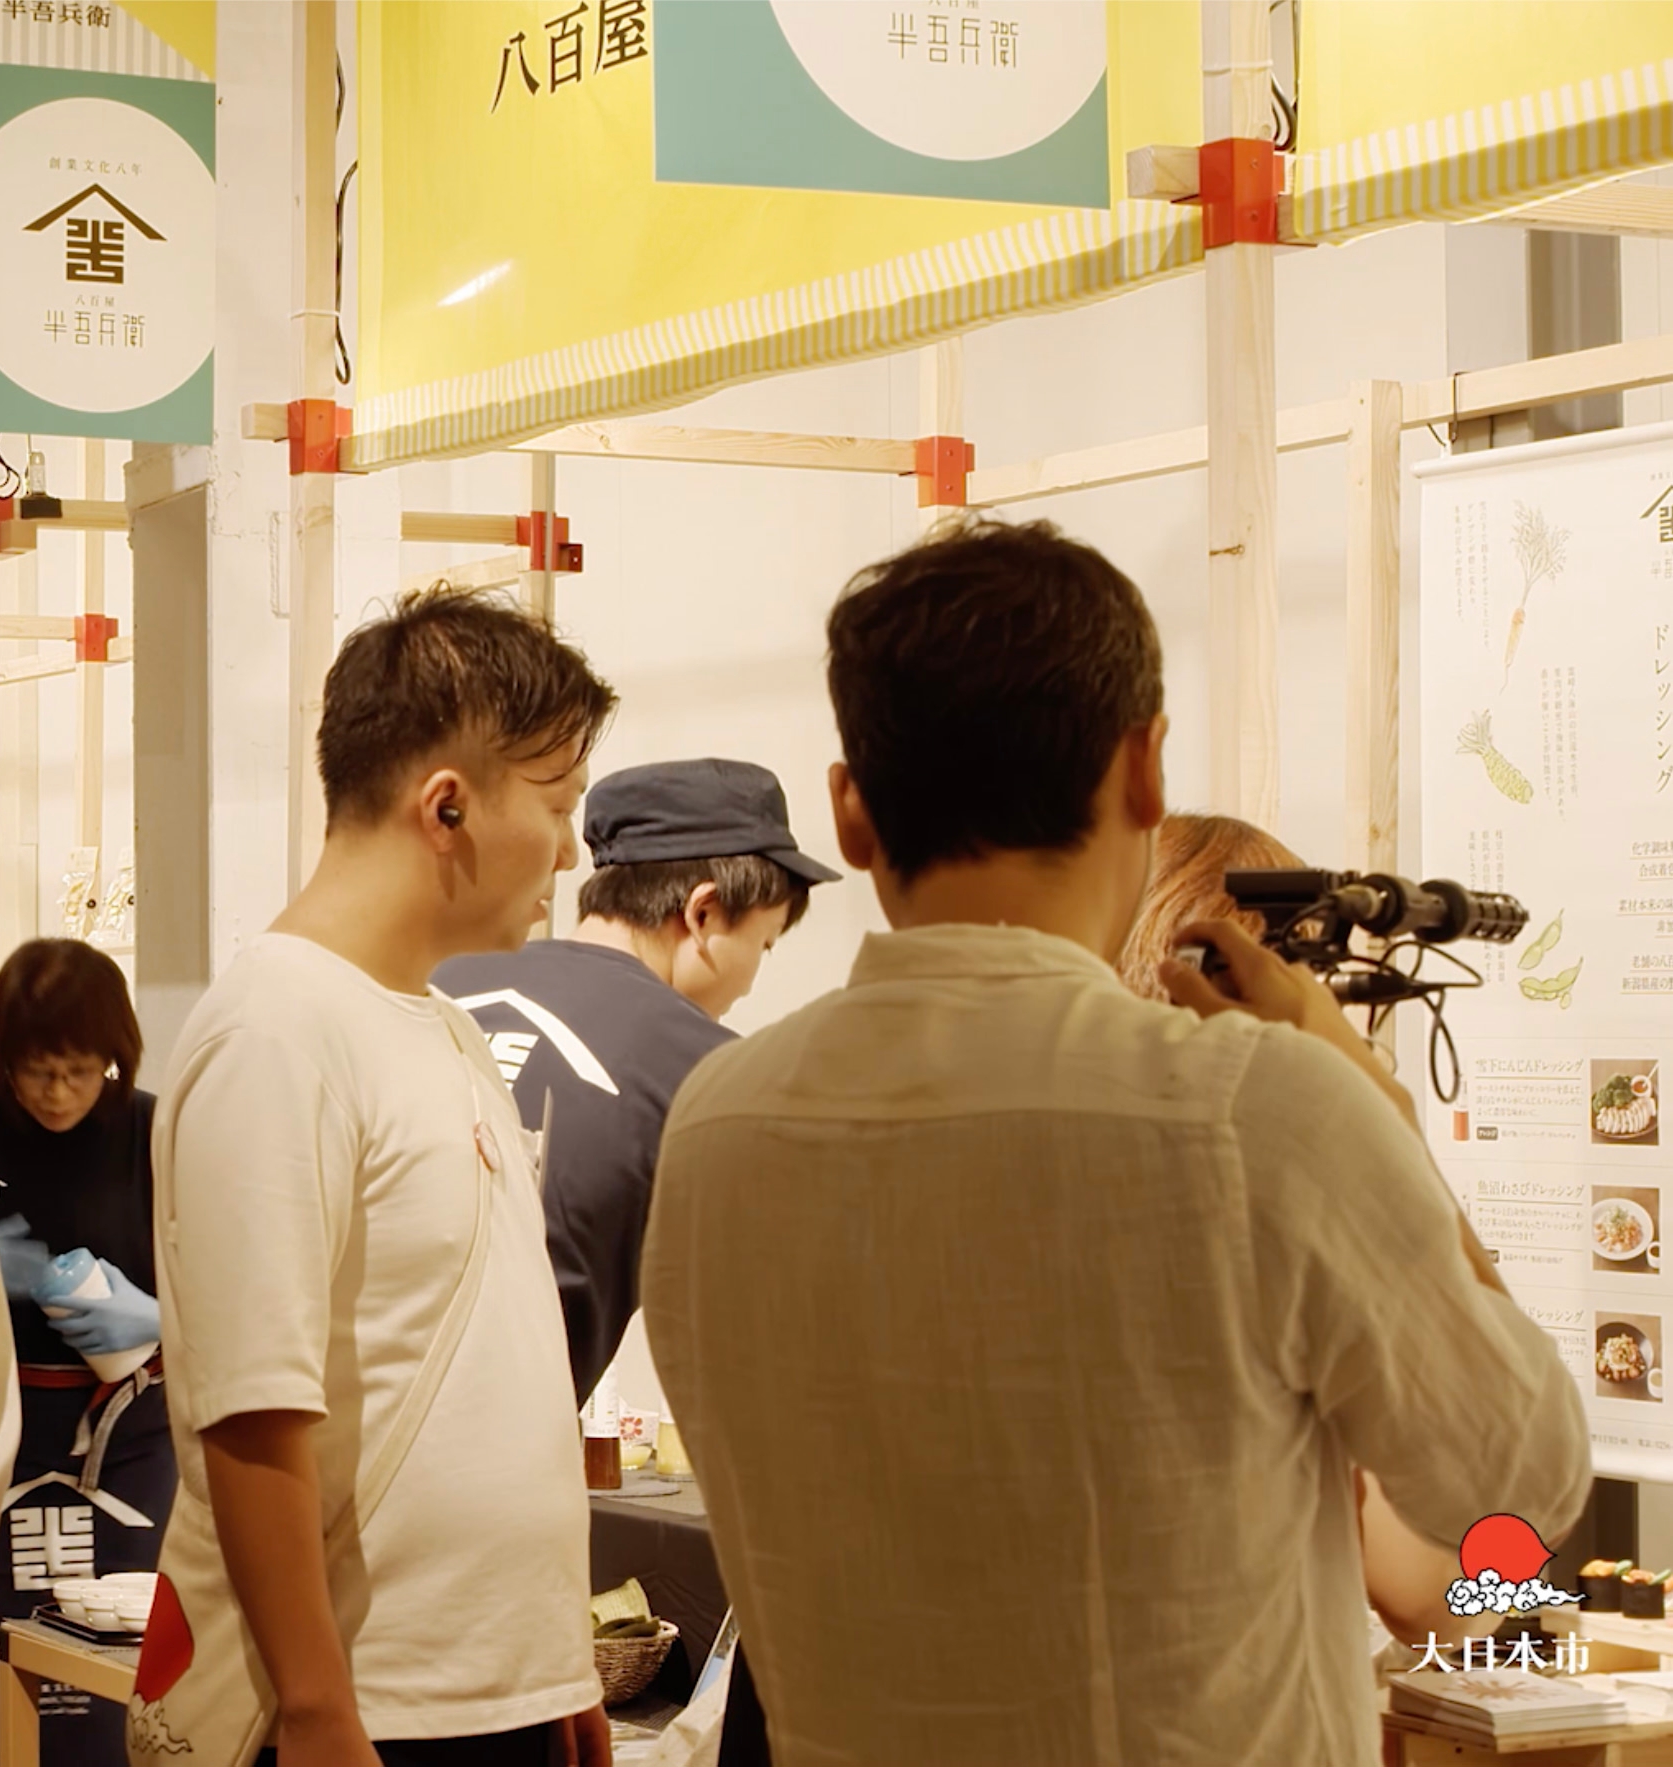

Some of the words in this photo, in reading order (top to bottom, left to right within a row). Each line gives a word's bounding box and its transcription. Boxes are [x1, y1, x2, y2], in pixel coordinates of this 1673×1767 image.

[2, 0, 111, 28] 半吾兵衛
[490, 0, 648, 114] 八百屋
[888, 12, 1019, 68] 半吾兵衛
[49, 157, 143, 176] 創業文化八年
[44, 310, 145, 348] 半吾兵衛
[1655, 624, 1673, 794] ドレッシング
